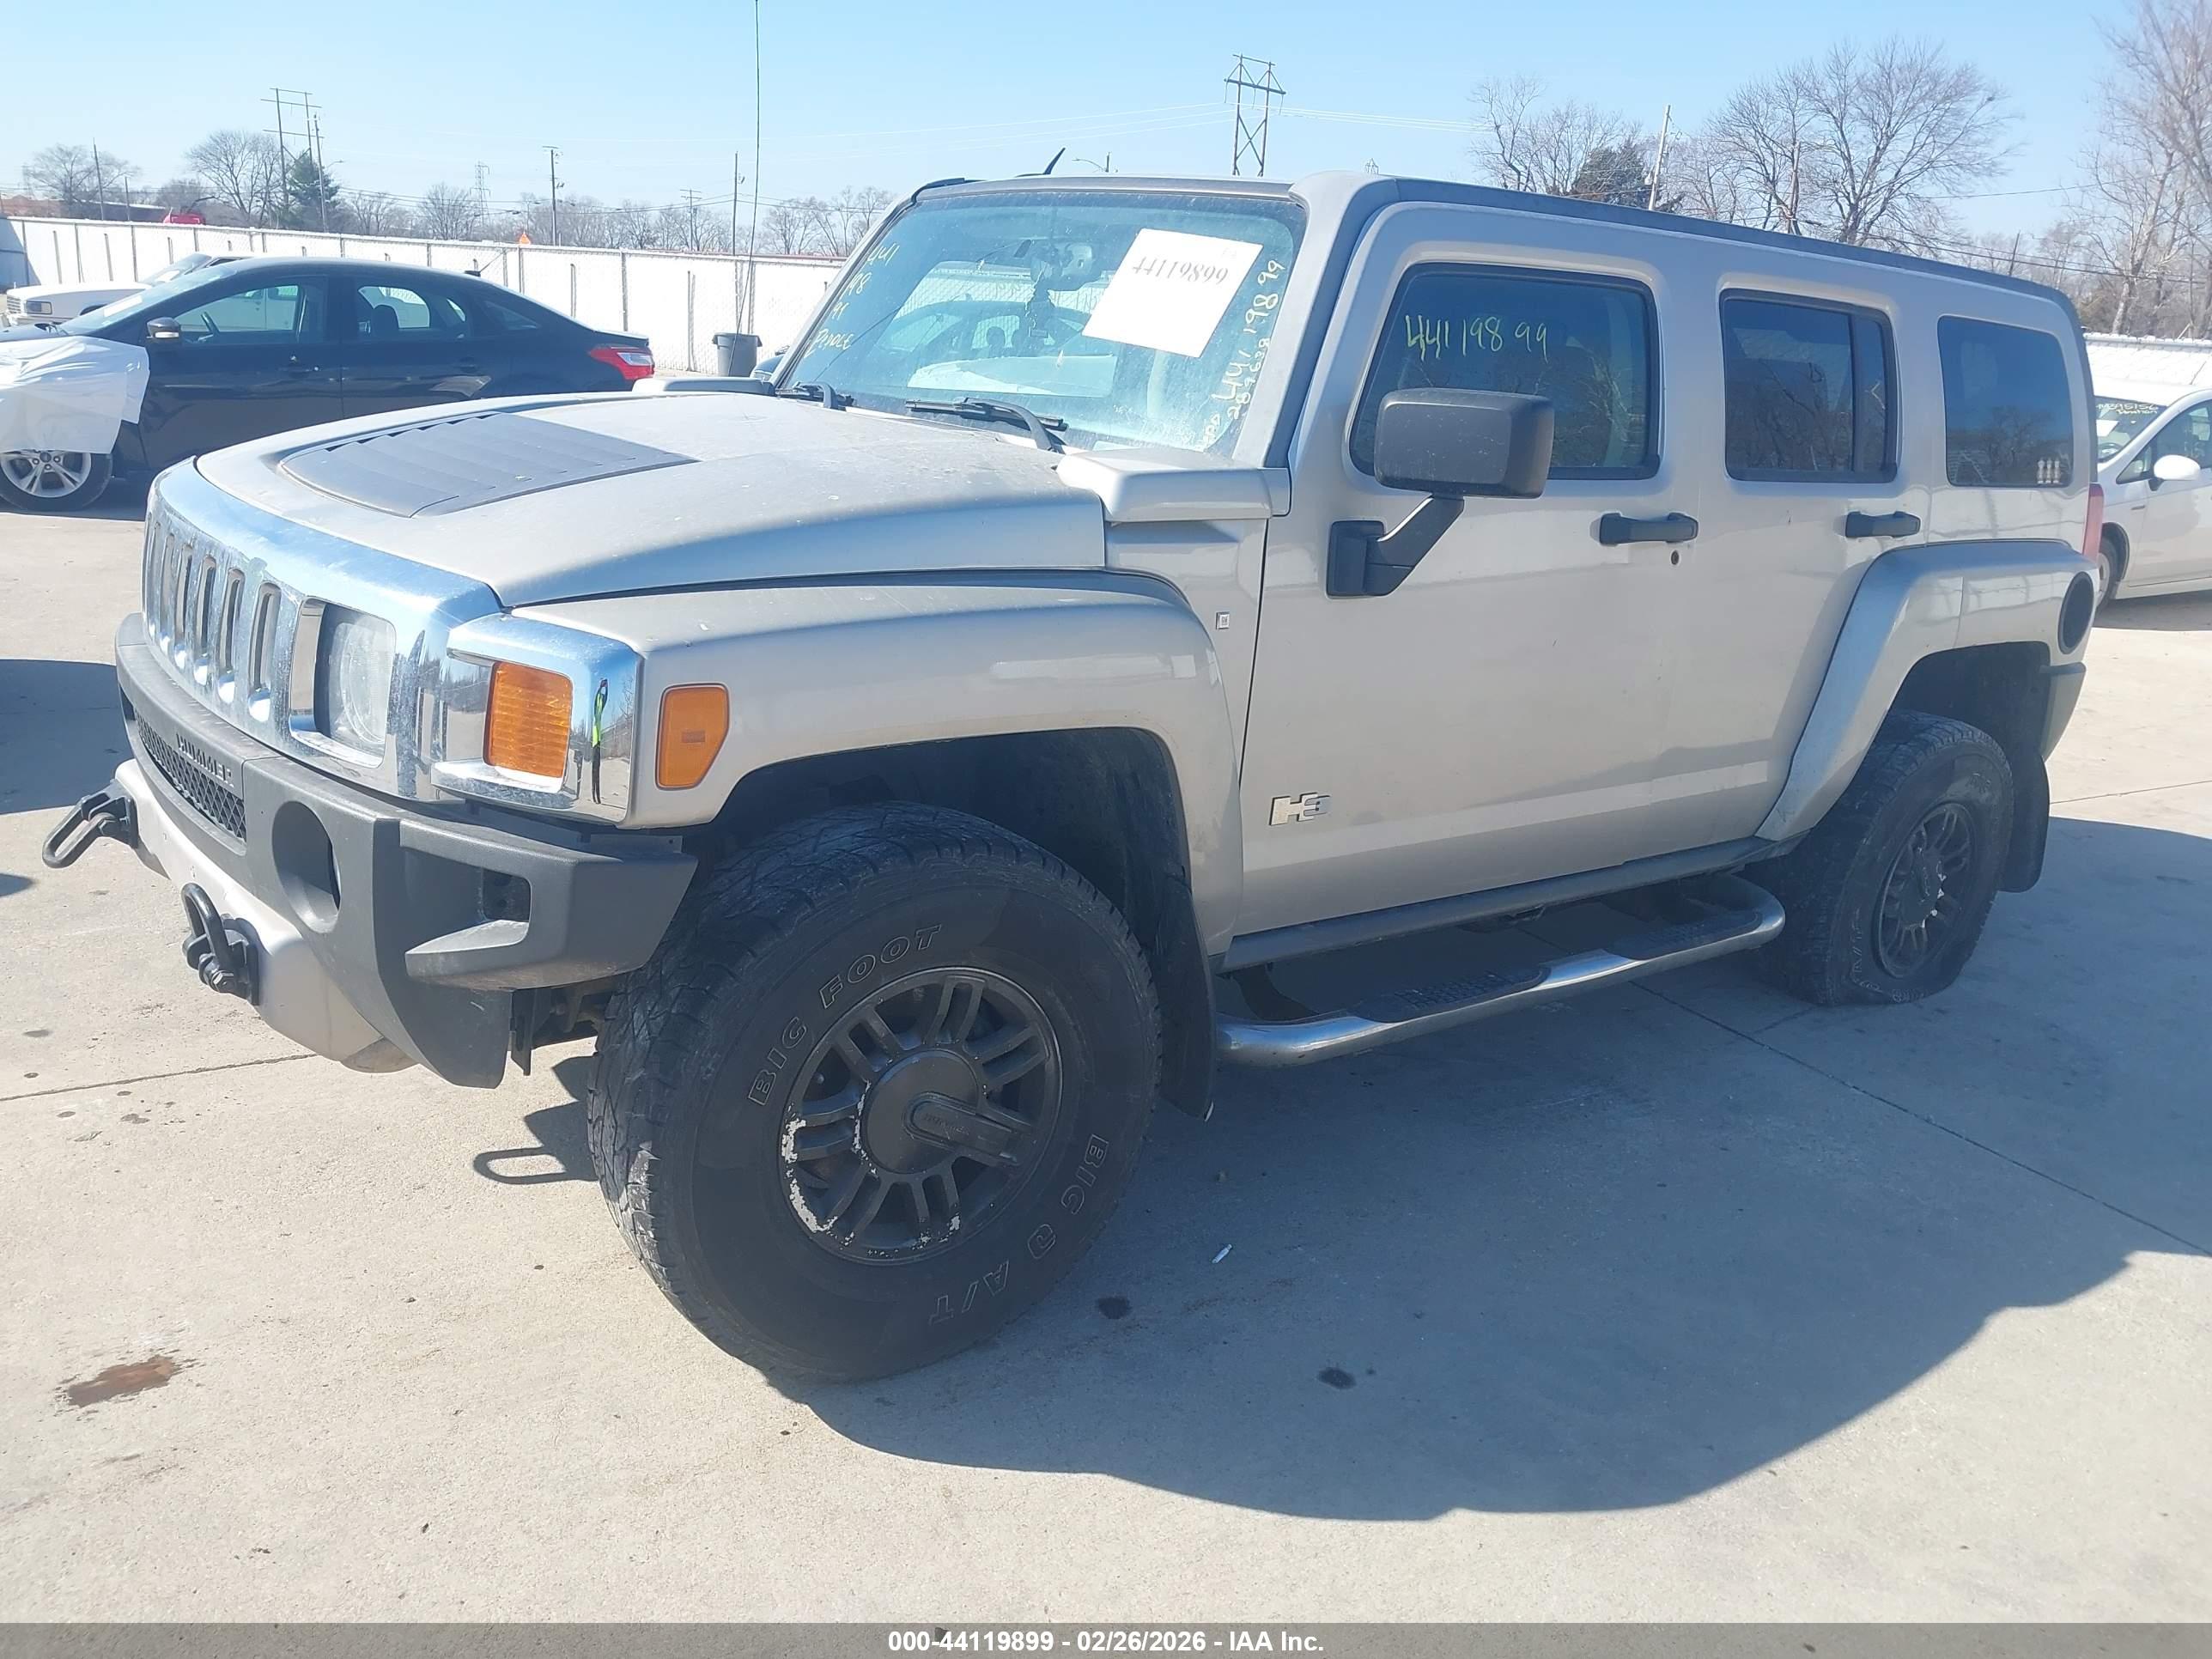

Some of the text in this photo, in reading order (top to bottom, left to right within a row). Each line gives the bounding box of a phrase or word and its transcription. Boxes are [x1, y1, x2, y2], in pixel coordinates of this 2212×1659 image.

[1132, 257, 1229, 285] 44119899
[175, 732, 234, 788] HUMMER
[1269, 792, 1330, 826] H3
[748, 924, 942, 1106] BIG FOOT
[1060, 1133, 1109, 1215] BIG
[928, 1260, 1010, 1327] A/T
